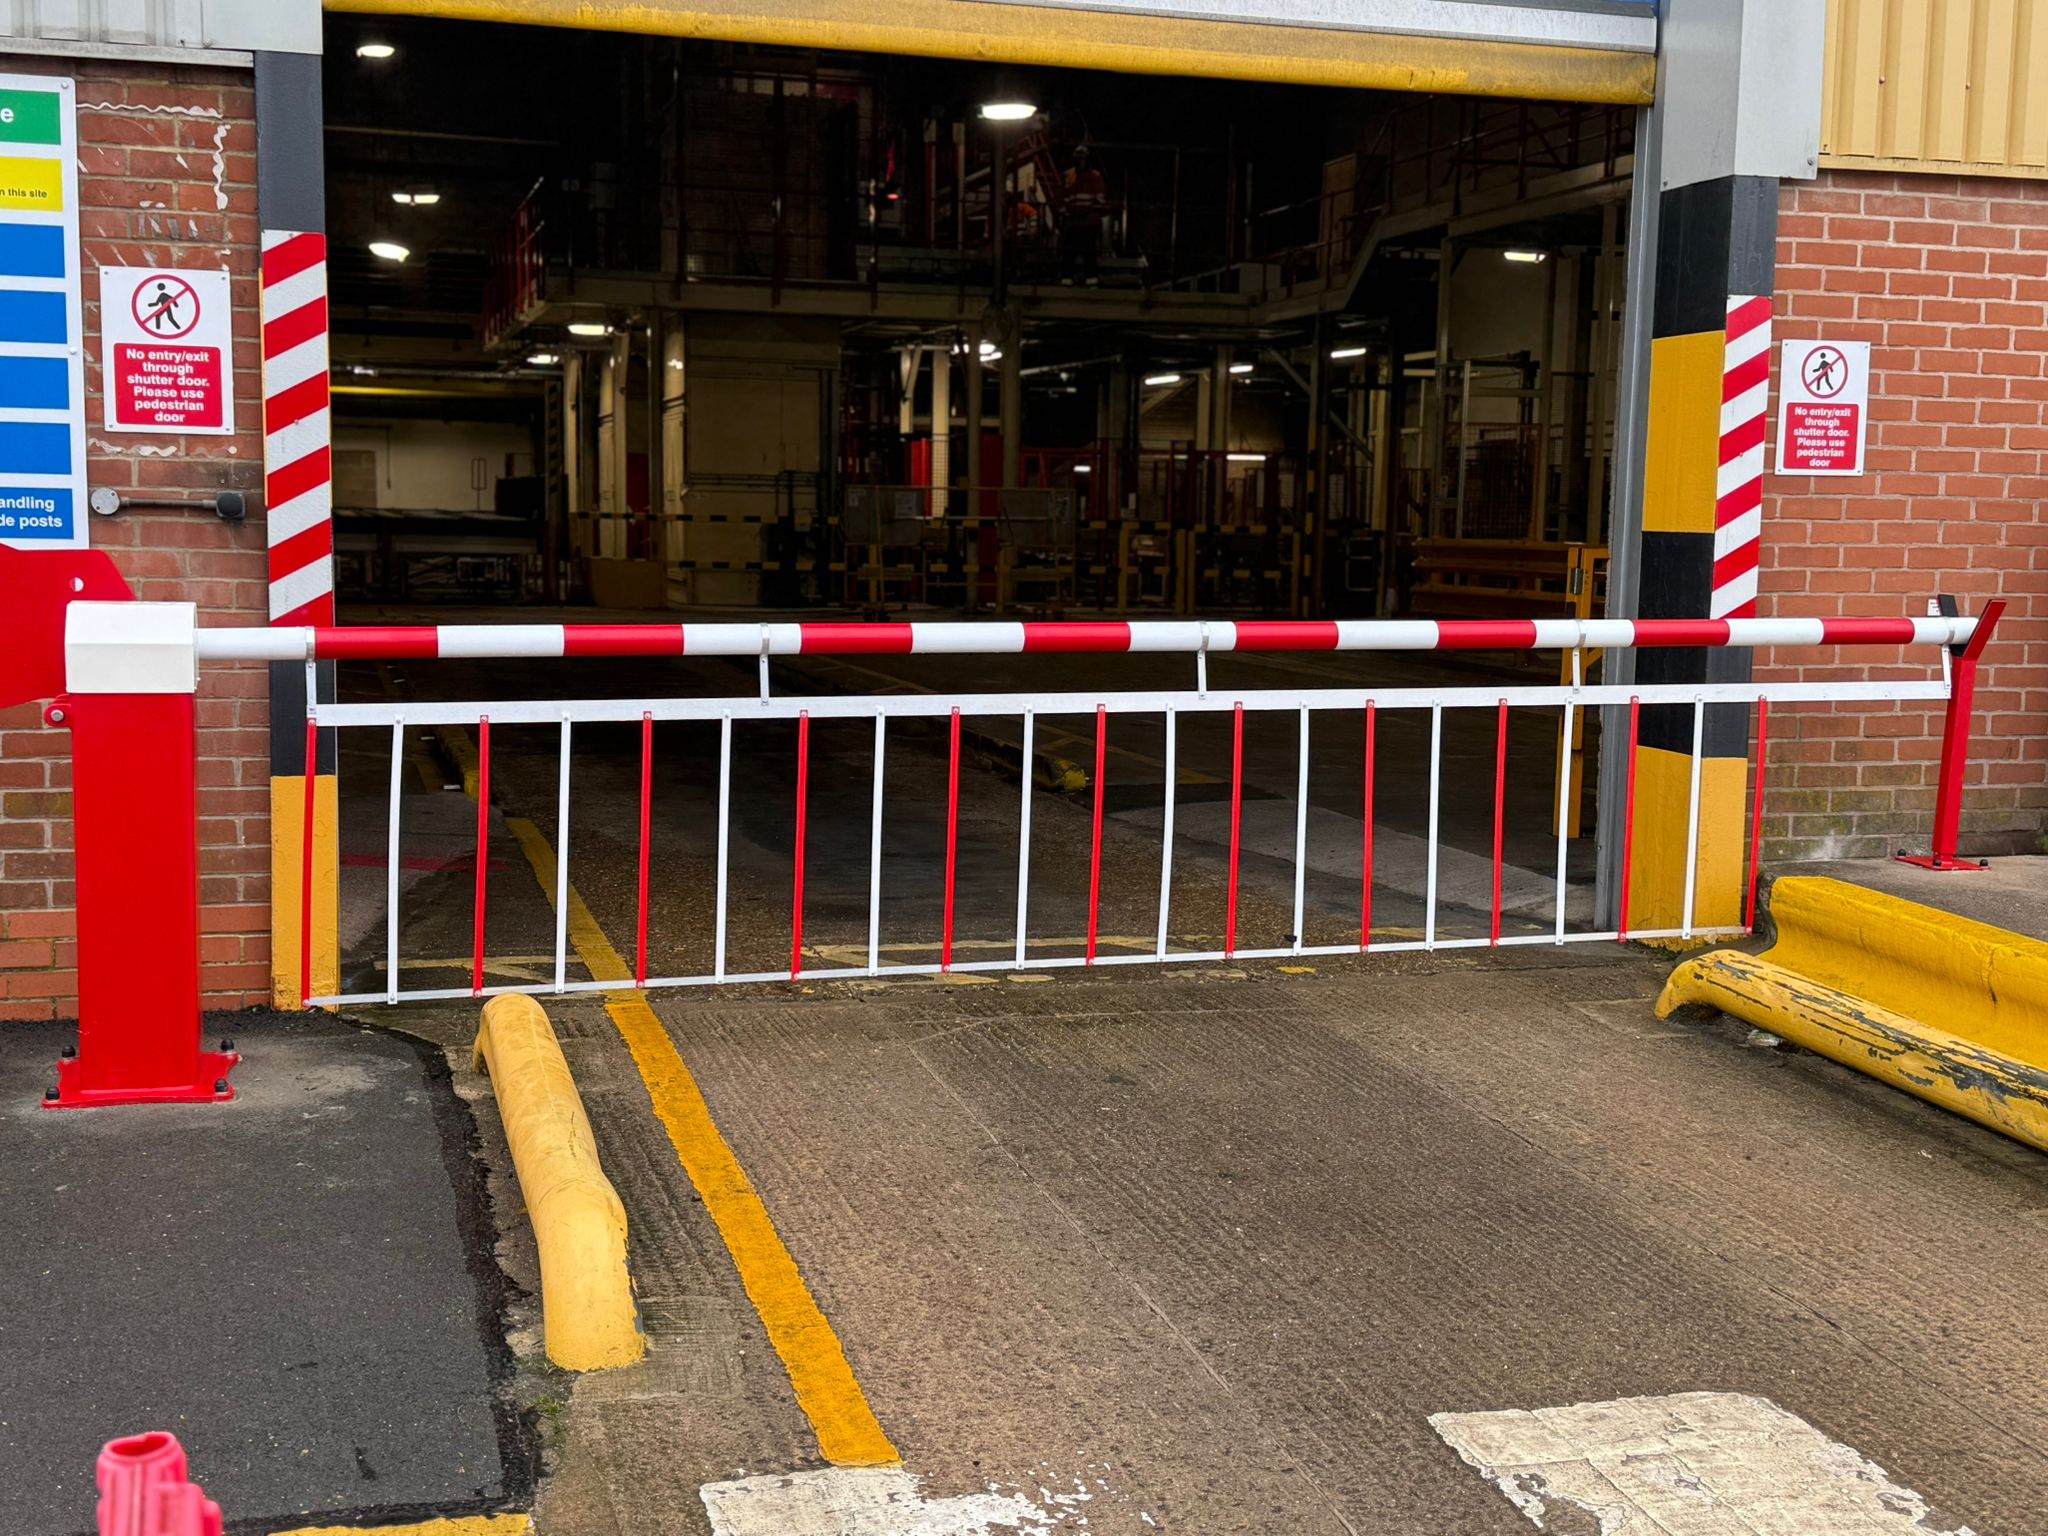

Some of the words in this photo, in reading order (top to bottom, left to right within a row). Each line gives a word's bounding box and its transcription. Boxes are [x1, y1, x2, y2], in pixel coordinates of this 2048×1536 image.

[8, 187, 27, 198] this
[29, 189, 48, 199] site
[126, 348, 145, 360] No
[148, 351, 209, 363] entry/exit
[142, 362, 194, 376] through
[127, 374, 174, 386] shutter
[177, 376, 210, 387] door.
[134, 386, 177, 398] Please
[181, 389, 205, 399] use
[134, 400, 204, 412] pedestrian
[1794, 406, 1808, 416] No
[1809, 408, 1851, 418] entry/exit
[154, 411, 186, 423] door
[1804, 417, 1840, 428] through
[1793, 427, 1825, 437] shutter
[1827, 428, 1850, 437] door.
[1797, 437, 1827, 447] Please
[1796, 448, 1845, 458] pedestrian
[1809, 458, 1831, 467] door
[19, 515, 63, 530] posts
